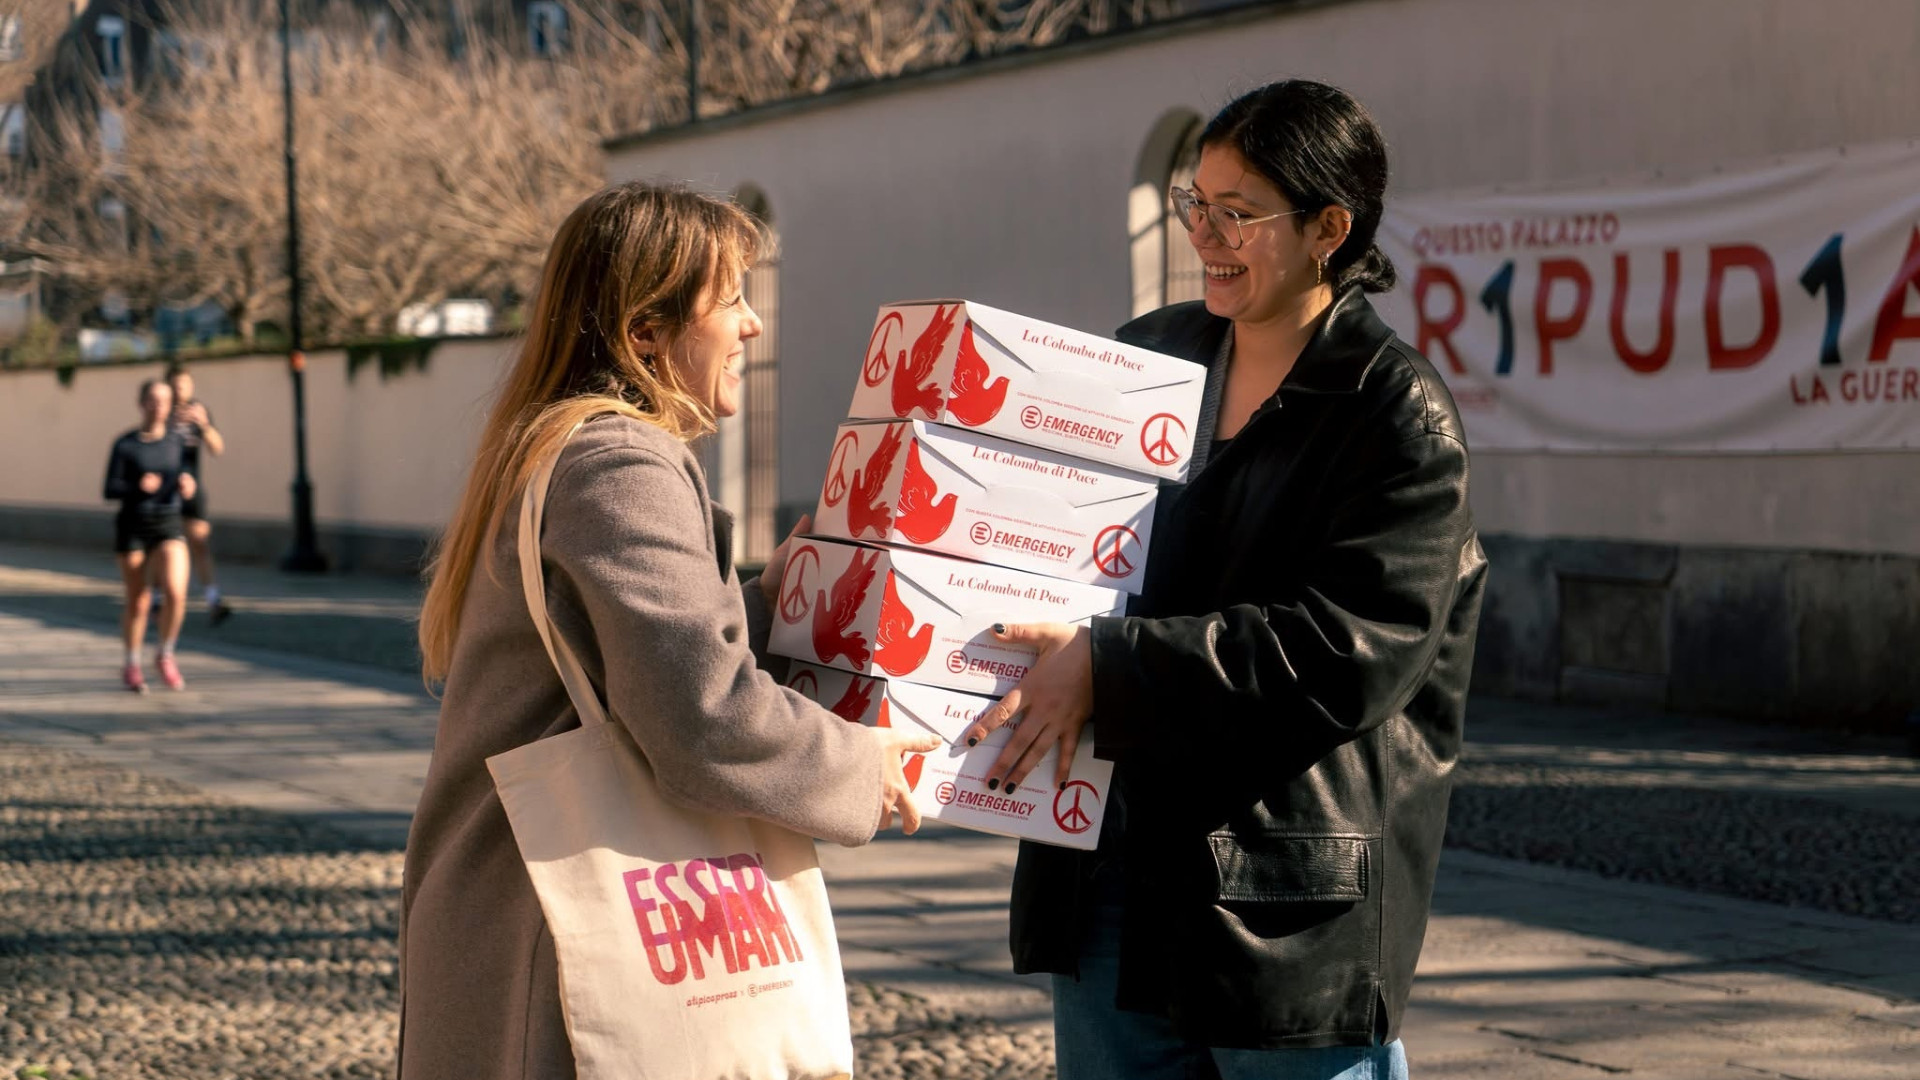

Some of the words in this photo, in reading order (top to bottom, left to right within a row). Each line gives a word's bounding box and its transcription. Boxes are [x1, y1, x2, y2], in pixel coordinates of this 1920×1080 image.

[1412, 221, 1504, 258] QUESTO
[1510, 212, 1620, 248] PALAZZO
[1022, 329, 1039, 344] La
[1042, 335, 1096, 359] Colomba
[1098, 350, 1112, 363] di
[1113, 353, 1145, 372] Pace
[1789, 373, 1830, 406] LA
[1840, 367, 1920, 404] GUER
[1043, 414, 1124, 446] EMERGENCY
[972, 445, 989, 460] La
[993, 451, 1048, 475] Colomba
[1051, 464, 1065, 478] di
[1067, 467, 1099, 485] Pace
[993, 530, 1076, 559] EMERGENCY
[947, 573, 964, 587] La
[968, 577, 1021, 597] Colomba
[1023, 587, 1037, 600] di
[1039, 589, 1070, 605] Pace
[969, 657, 1029, 679] EMERGEN
[944, 705, 961, 719] La
[957, 790, 1037, 817] EMERGENCY
[634, 893, 804, 985] UMANI
[758, 979, 794, 993] EMERGENCY
